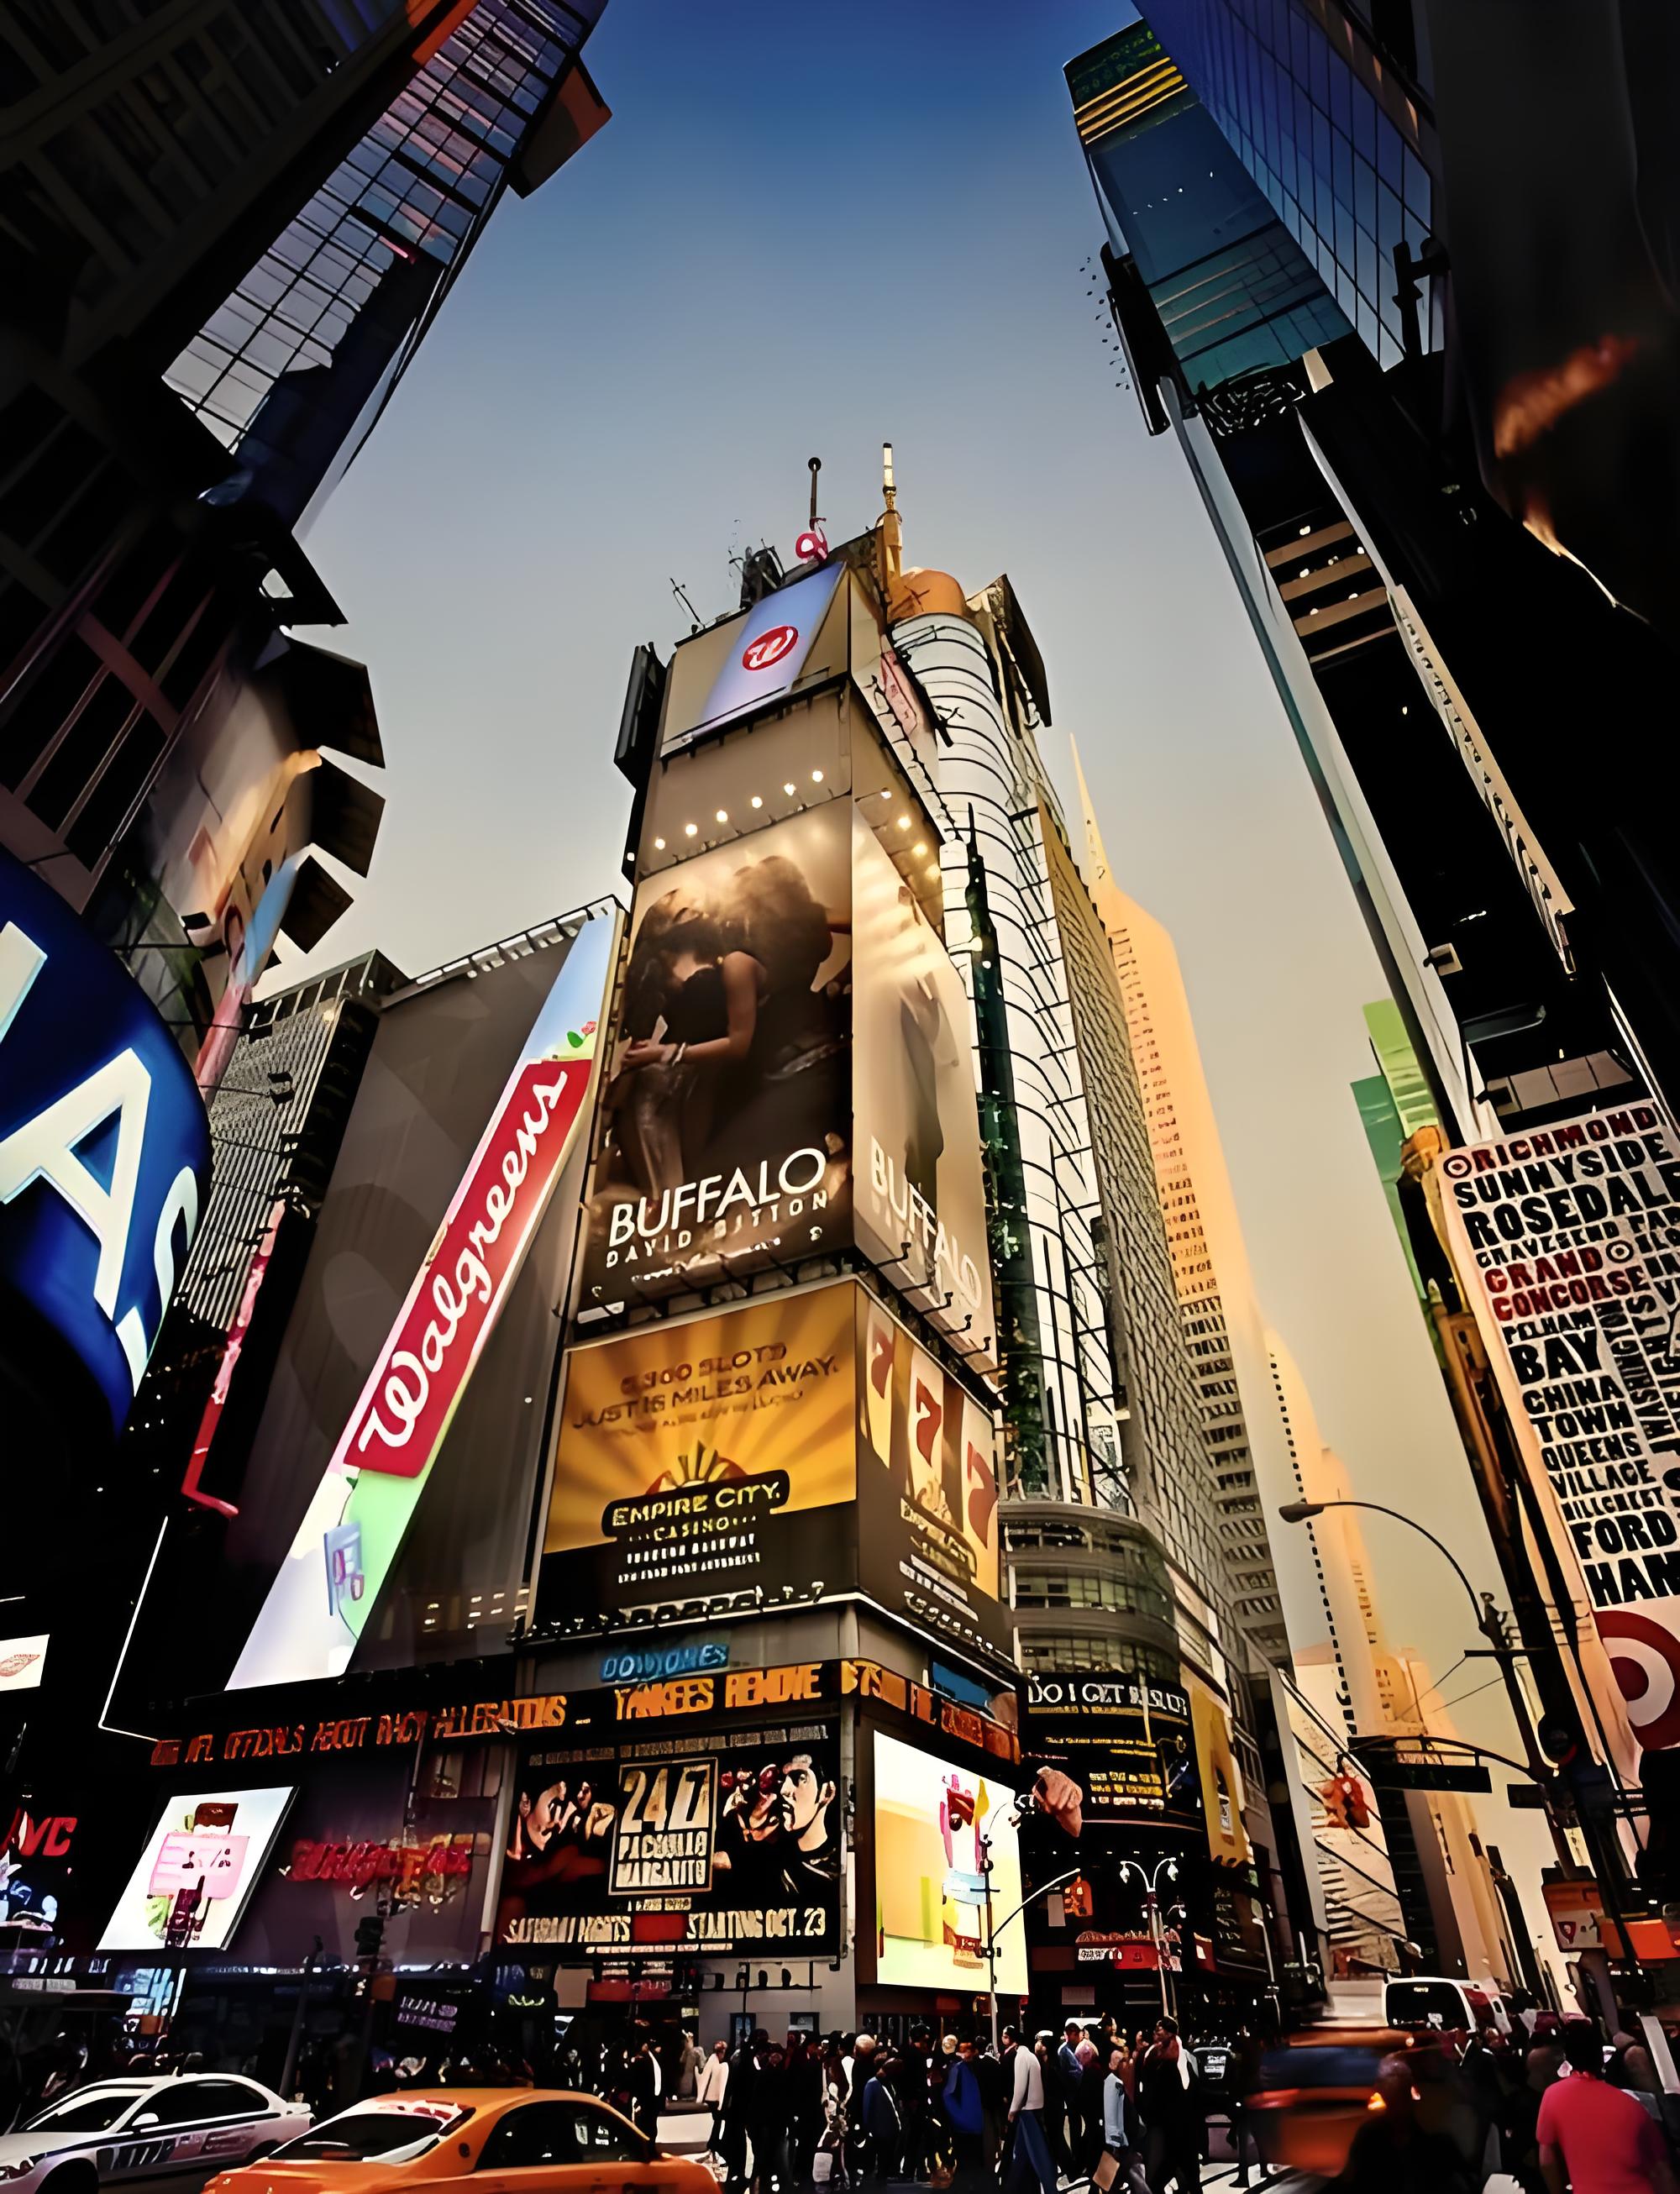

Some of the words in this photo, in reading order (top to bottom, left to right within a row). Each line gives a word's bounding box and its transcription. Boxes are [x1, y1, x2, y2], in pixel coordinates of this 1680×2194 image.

[1472, 1106, 1658, 1173] RICHMOND
[1453, 1131, 1673, 1209] SUNNYSIDE
[608, 1147, 827, 1247] BUFFALO
[870, 1135, 983, 1310] BUFFALO
[358, 1070, 569, 1452] Walgreens
[606, 1230, 692, 1268] DAVID
[1484, 1247, 1604, 1294] GRAND
[1509, 1330, 1603, 1385] BAY
[672, 1376, 753, 1409] MILES
[1522, 1374, 1625, 1415] CHINA
[1530, 1401, 1635, 1443] TOWN
[1541, 1431, 1644, 1472] QUEENS
[1549, 1459, 1656, 1499] VILLAGE
[612, 1494, 709, 1527] EMPIRE
[1568, 1509, 1677, 1561] FORD
[614, 1677, 714, 1720] YANKEES
[803, 1907, 827, 1937] 23
